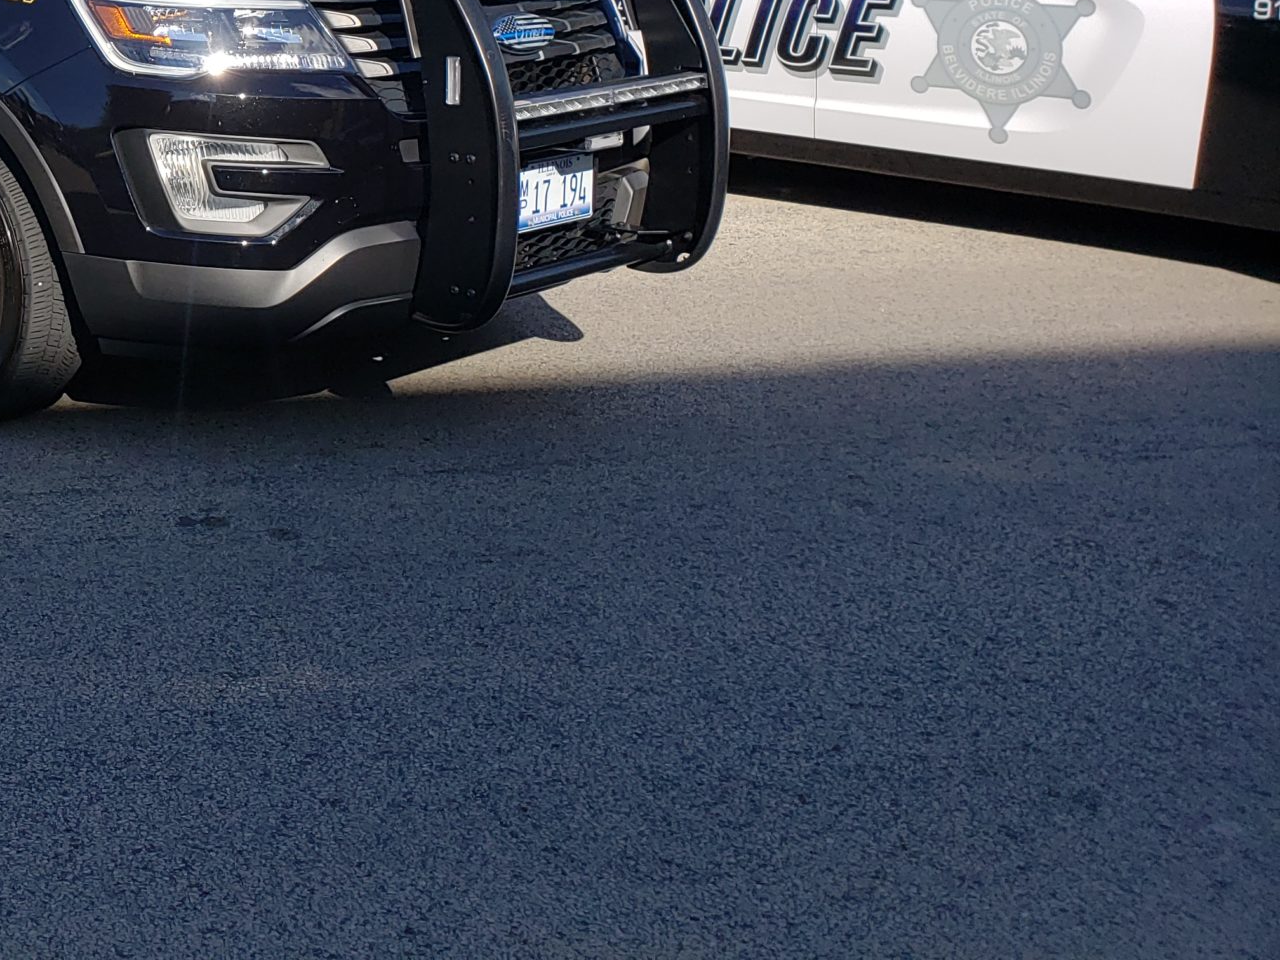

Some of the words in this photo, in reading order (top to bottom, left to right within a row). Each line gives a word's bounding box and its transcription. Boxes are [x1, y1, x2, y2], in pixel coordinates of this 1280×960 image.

[942, 44, 1008, 101] BELVIDERE
[1010, 51, 1057, 99] ILLINOIS
[532, 178, 552, 214] 17
[560, 171, 587, 208] 194
[558, 208, 575, 220] POLICE
